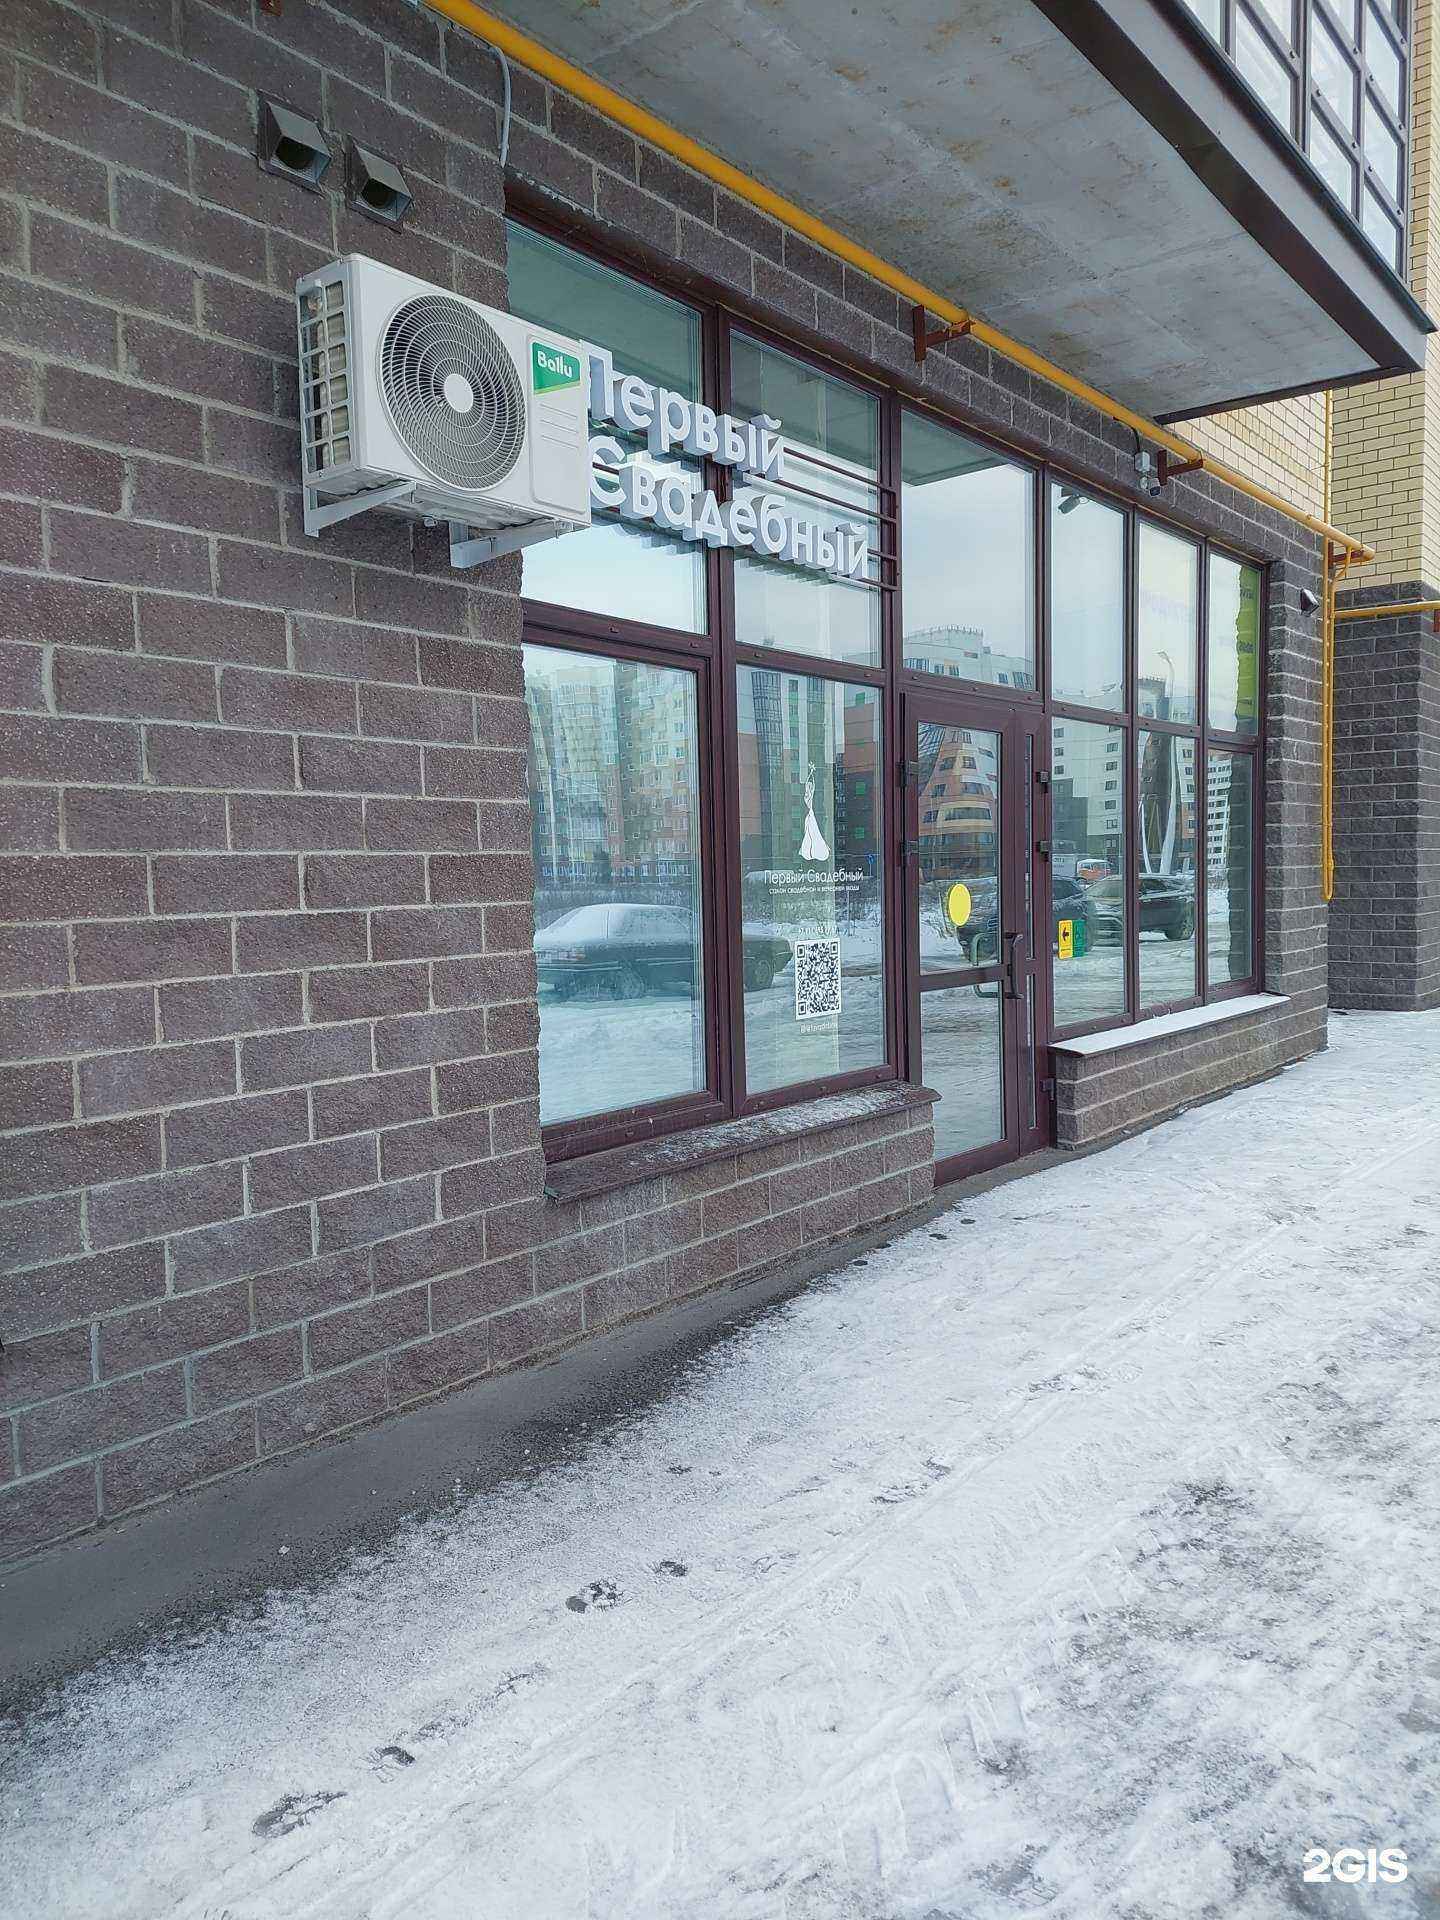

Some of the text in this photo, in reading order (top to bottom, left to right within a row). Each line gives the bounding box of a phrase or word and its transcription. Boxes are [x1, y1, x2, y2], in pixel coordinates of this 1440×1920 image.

[537, 350, 573, 378] Ballu
[588, 435, 868, 580] Свадебный
[764, 867, 864, 886] Первый Свадебный
